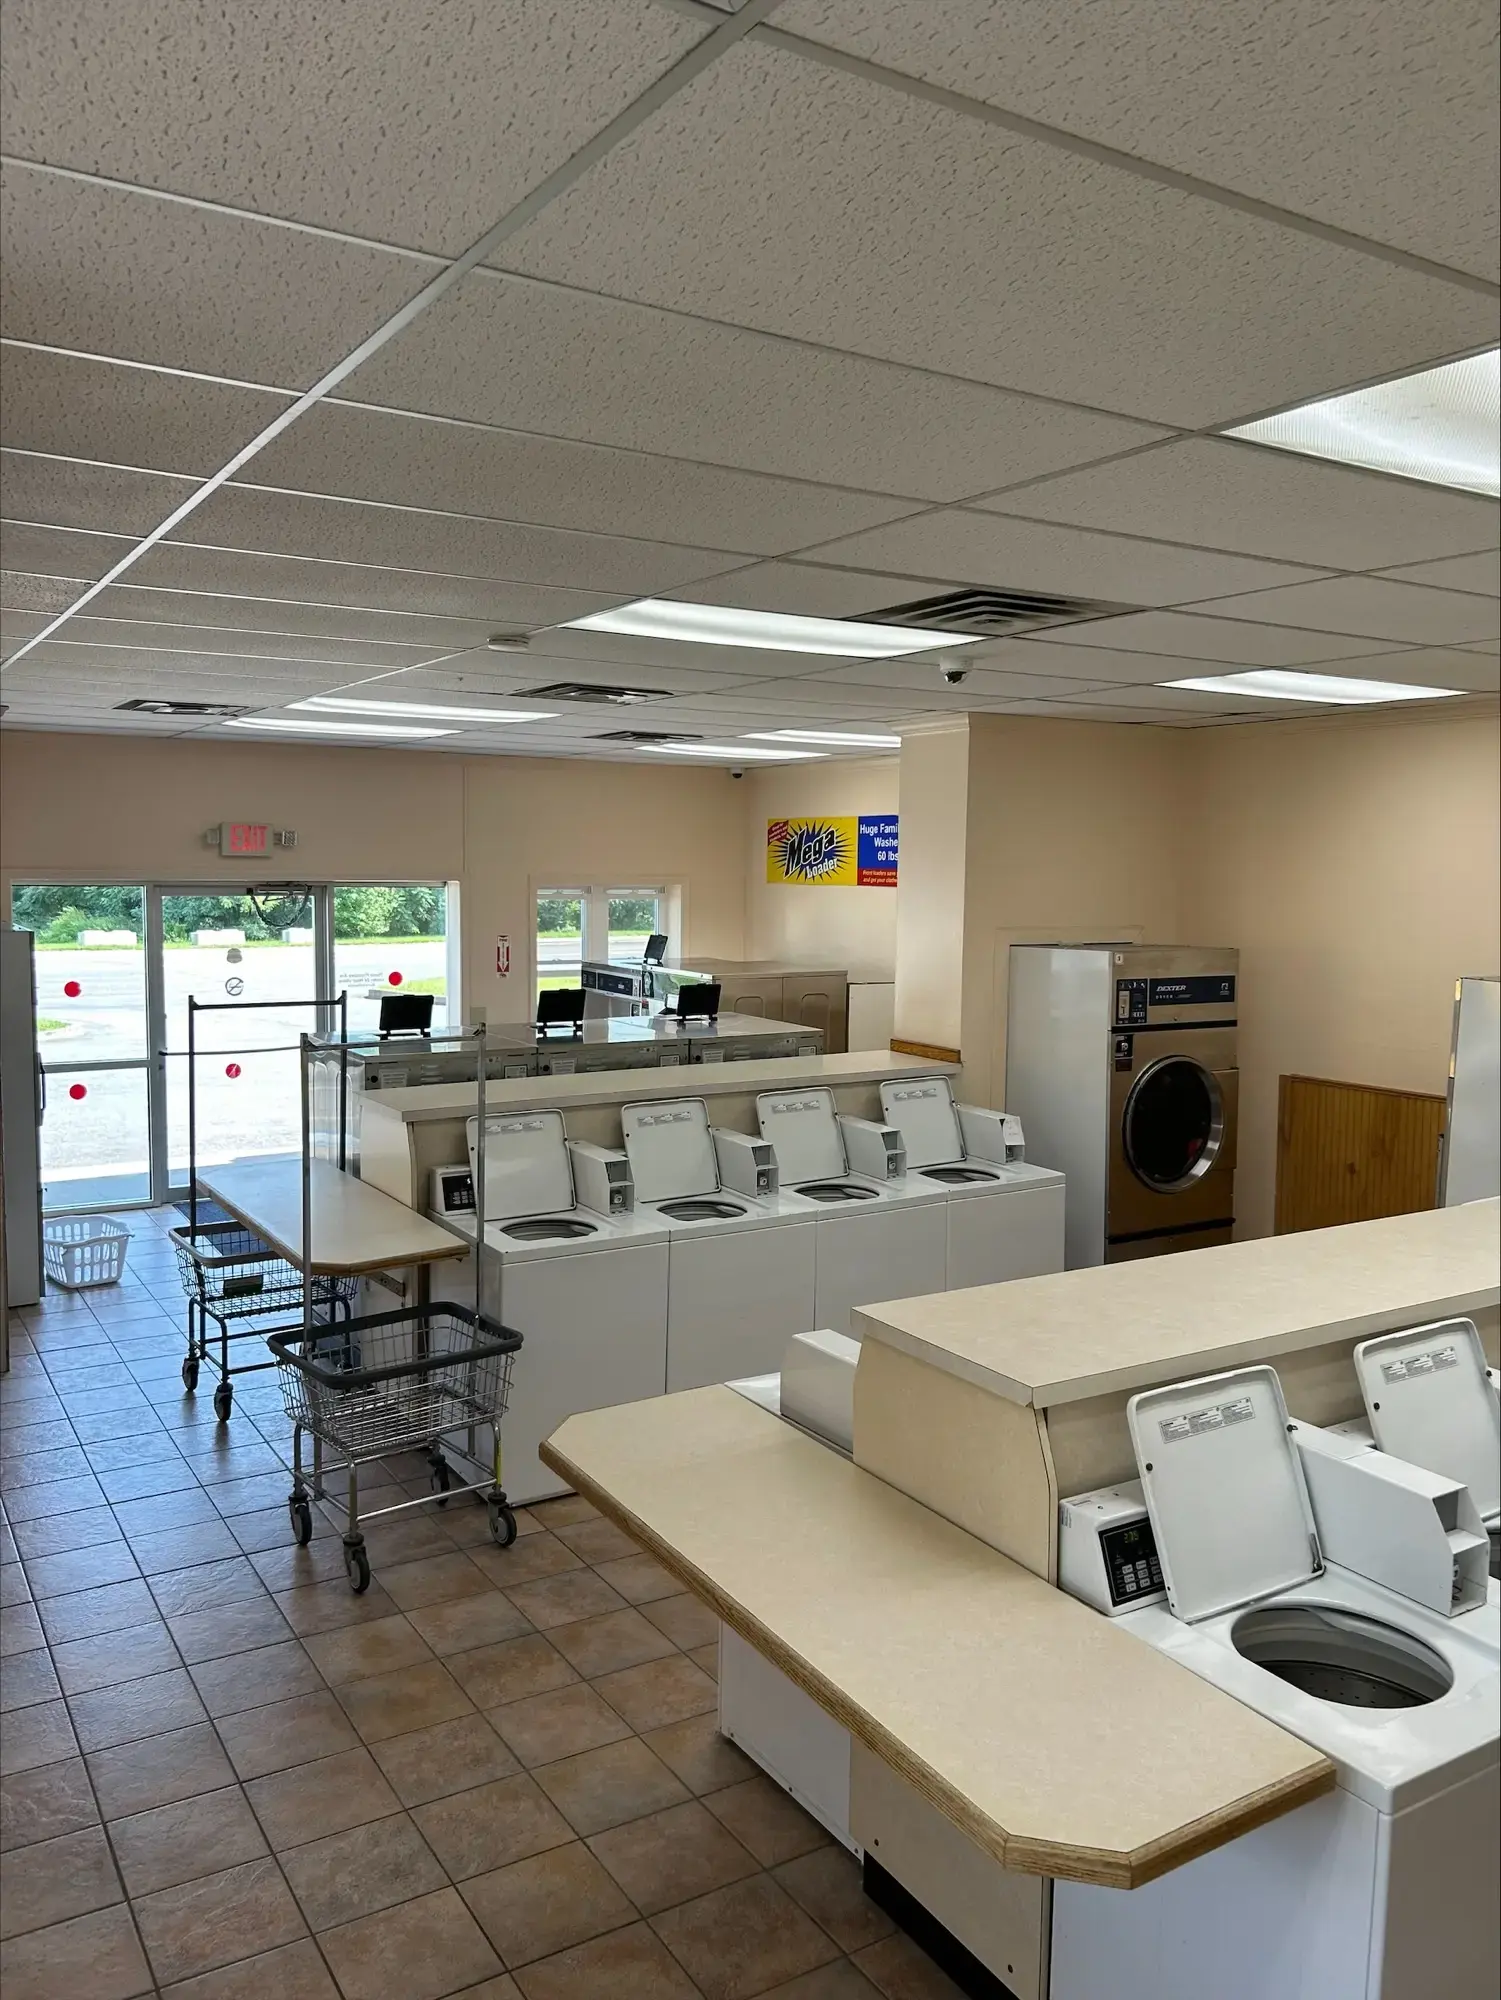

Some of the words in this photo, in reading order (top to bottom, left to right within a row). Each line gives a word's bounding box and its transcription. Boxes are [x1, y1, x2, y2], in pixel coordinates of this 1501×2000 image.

[230, 825, 268, 851] EXIT
[860, 824, 879, 836] Huge
[880, 823, 898, 834] Fami
[874, 837, 898, 847] Washe
[784, 826, 836, 879] Mega
[878, 851, 887, 861] 60
[806, 858, 838, 879] Loader
